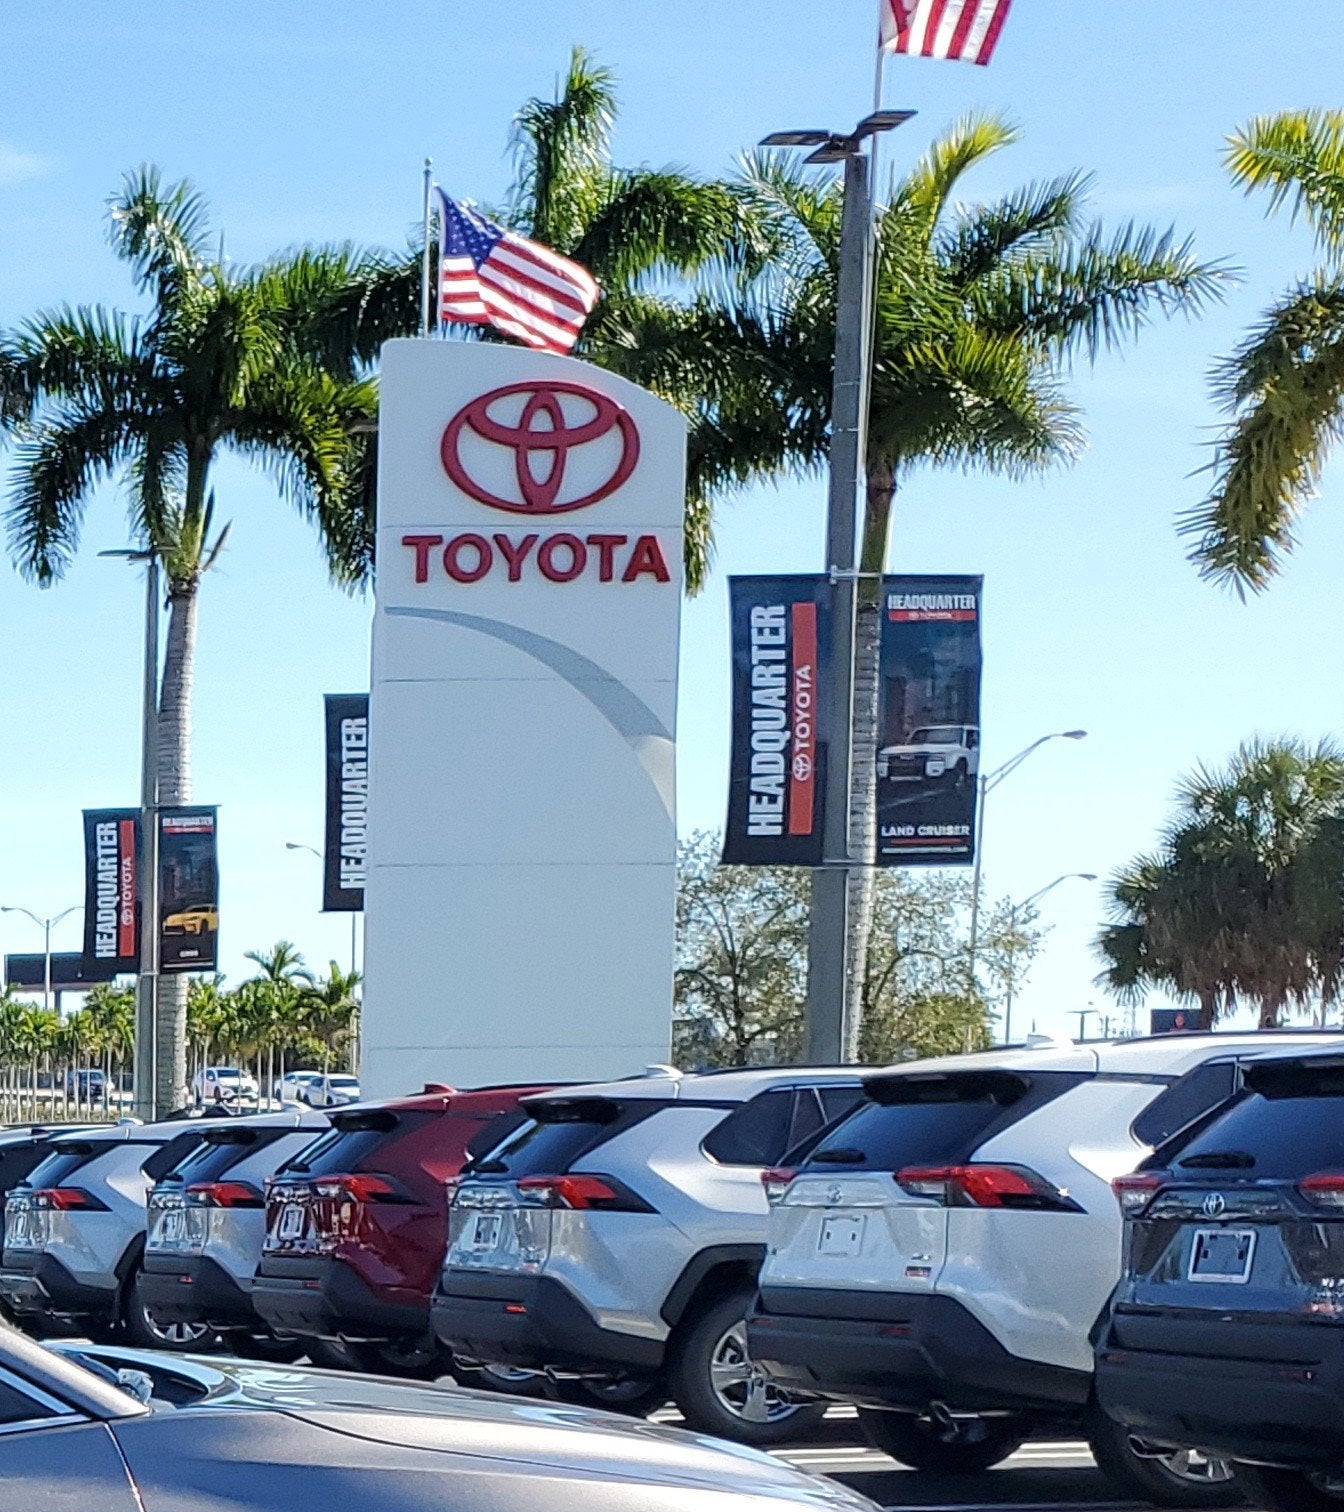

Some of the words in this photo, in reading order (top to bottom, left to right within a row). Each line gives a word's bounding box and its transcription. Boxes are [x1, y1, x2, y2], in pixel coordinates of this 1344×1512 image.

[402, 533, 670, 583] TOYOTA
[888, 594, 975, 610] HEADQUARTER
[747, 604, 789, 836] HEADQUARTER
[794, 665, 812, 751] TOYOTA
[881, 826, 915, 837] LAND
[917, 825, 970, 836] CRUISER
[95, 822, 119, 958] HEADQUARTER
[122, 857, 134, 908] TOYOTA
